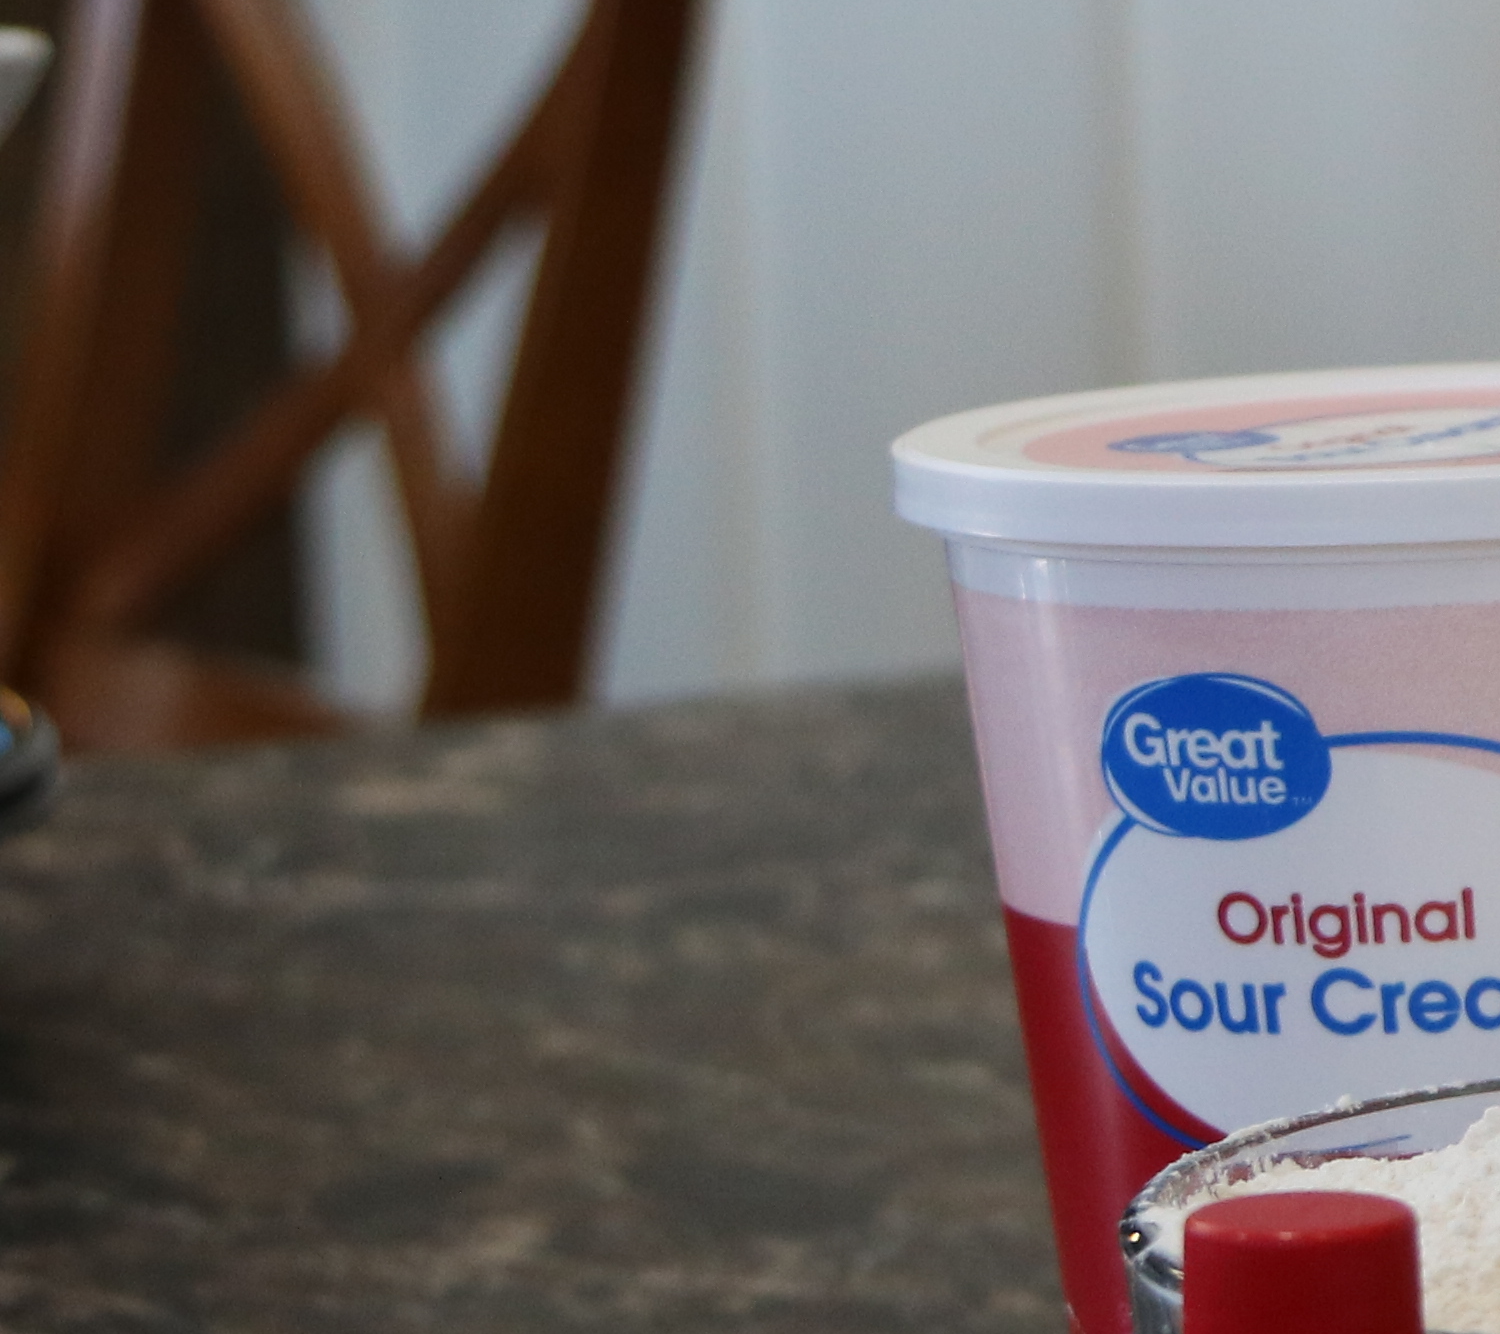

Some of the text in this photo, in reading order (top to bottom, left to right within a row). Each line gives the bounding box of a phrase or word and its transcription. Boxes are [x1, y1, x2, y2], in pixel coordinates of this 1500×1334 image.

[1123, 712, 1284, 770] Great
[1163, 767, 1287, 804] Value
[1216, 886, 1475, 958] Original
[1135, 959, 1287, 1036] Sour
